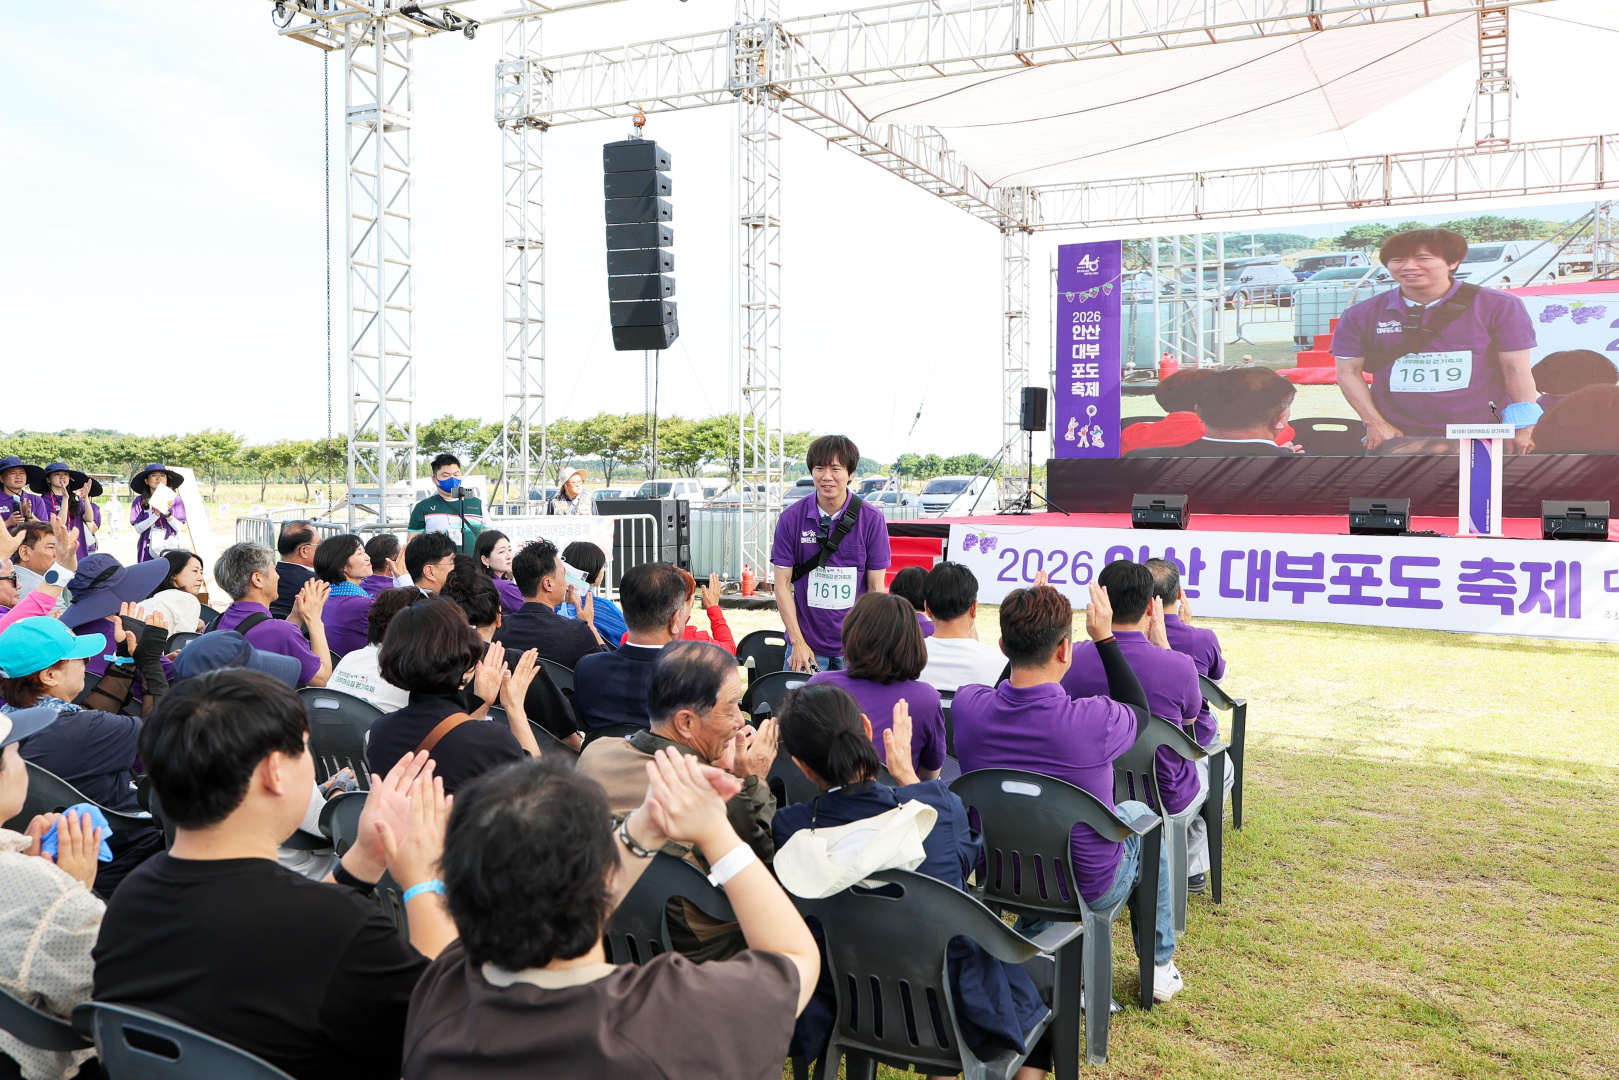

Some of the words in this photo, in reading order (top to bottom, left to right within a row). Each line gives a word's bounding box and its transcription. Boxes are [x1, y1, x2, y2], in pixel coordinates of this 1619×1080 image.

[1072, 311, 1101, 323] 2026
[1072, 324, 1101, 340] 안산
[1072, 343, 1100, 359] 대부
[1071, 363, 1099, 378] 포도
[1400, 367, 1462, 383] 1619
[1071, 381, 1099, 397] 축제
[516, 522, 590, 538] 자율관리어업공동체
[813, 583, 851, 599] 1619
[997, 547, 1094, 585] 2026
[1219, 549, 1444, 610] 대부포도
[1457, 557, 1582, 619] 축제
